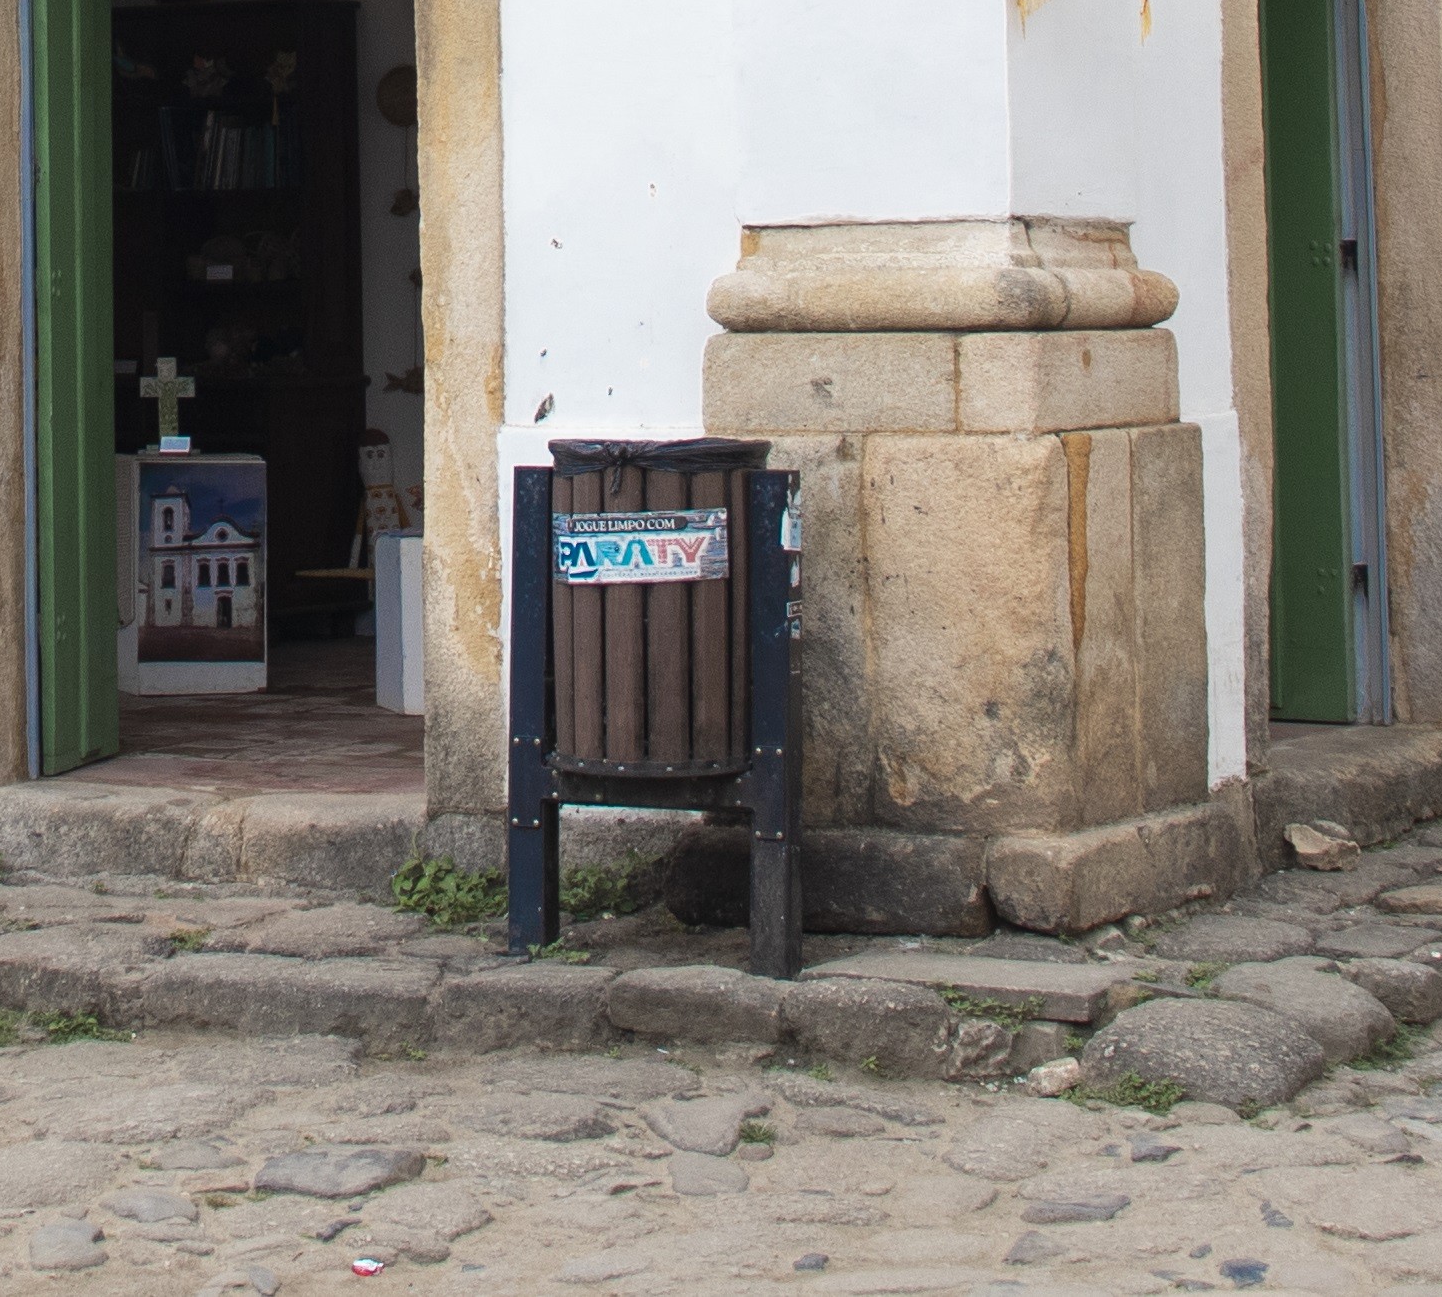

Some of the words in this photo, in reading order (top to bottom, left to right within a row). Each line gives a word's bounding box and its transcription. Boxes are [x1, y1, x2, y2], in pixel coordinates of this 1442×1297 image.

[574, 520, 605, 532] JOGUE
[608, 518, 645, 531] LIMPO
[647, 518, 675, 530] COM
[560, 536, 707, 568] PARATY
